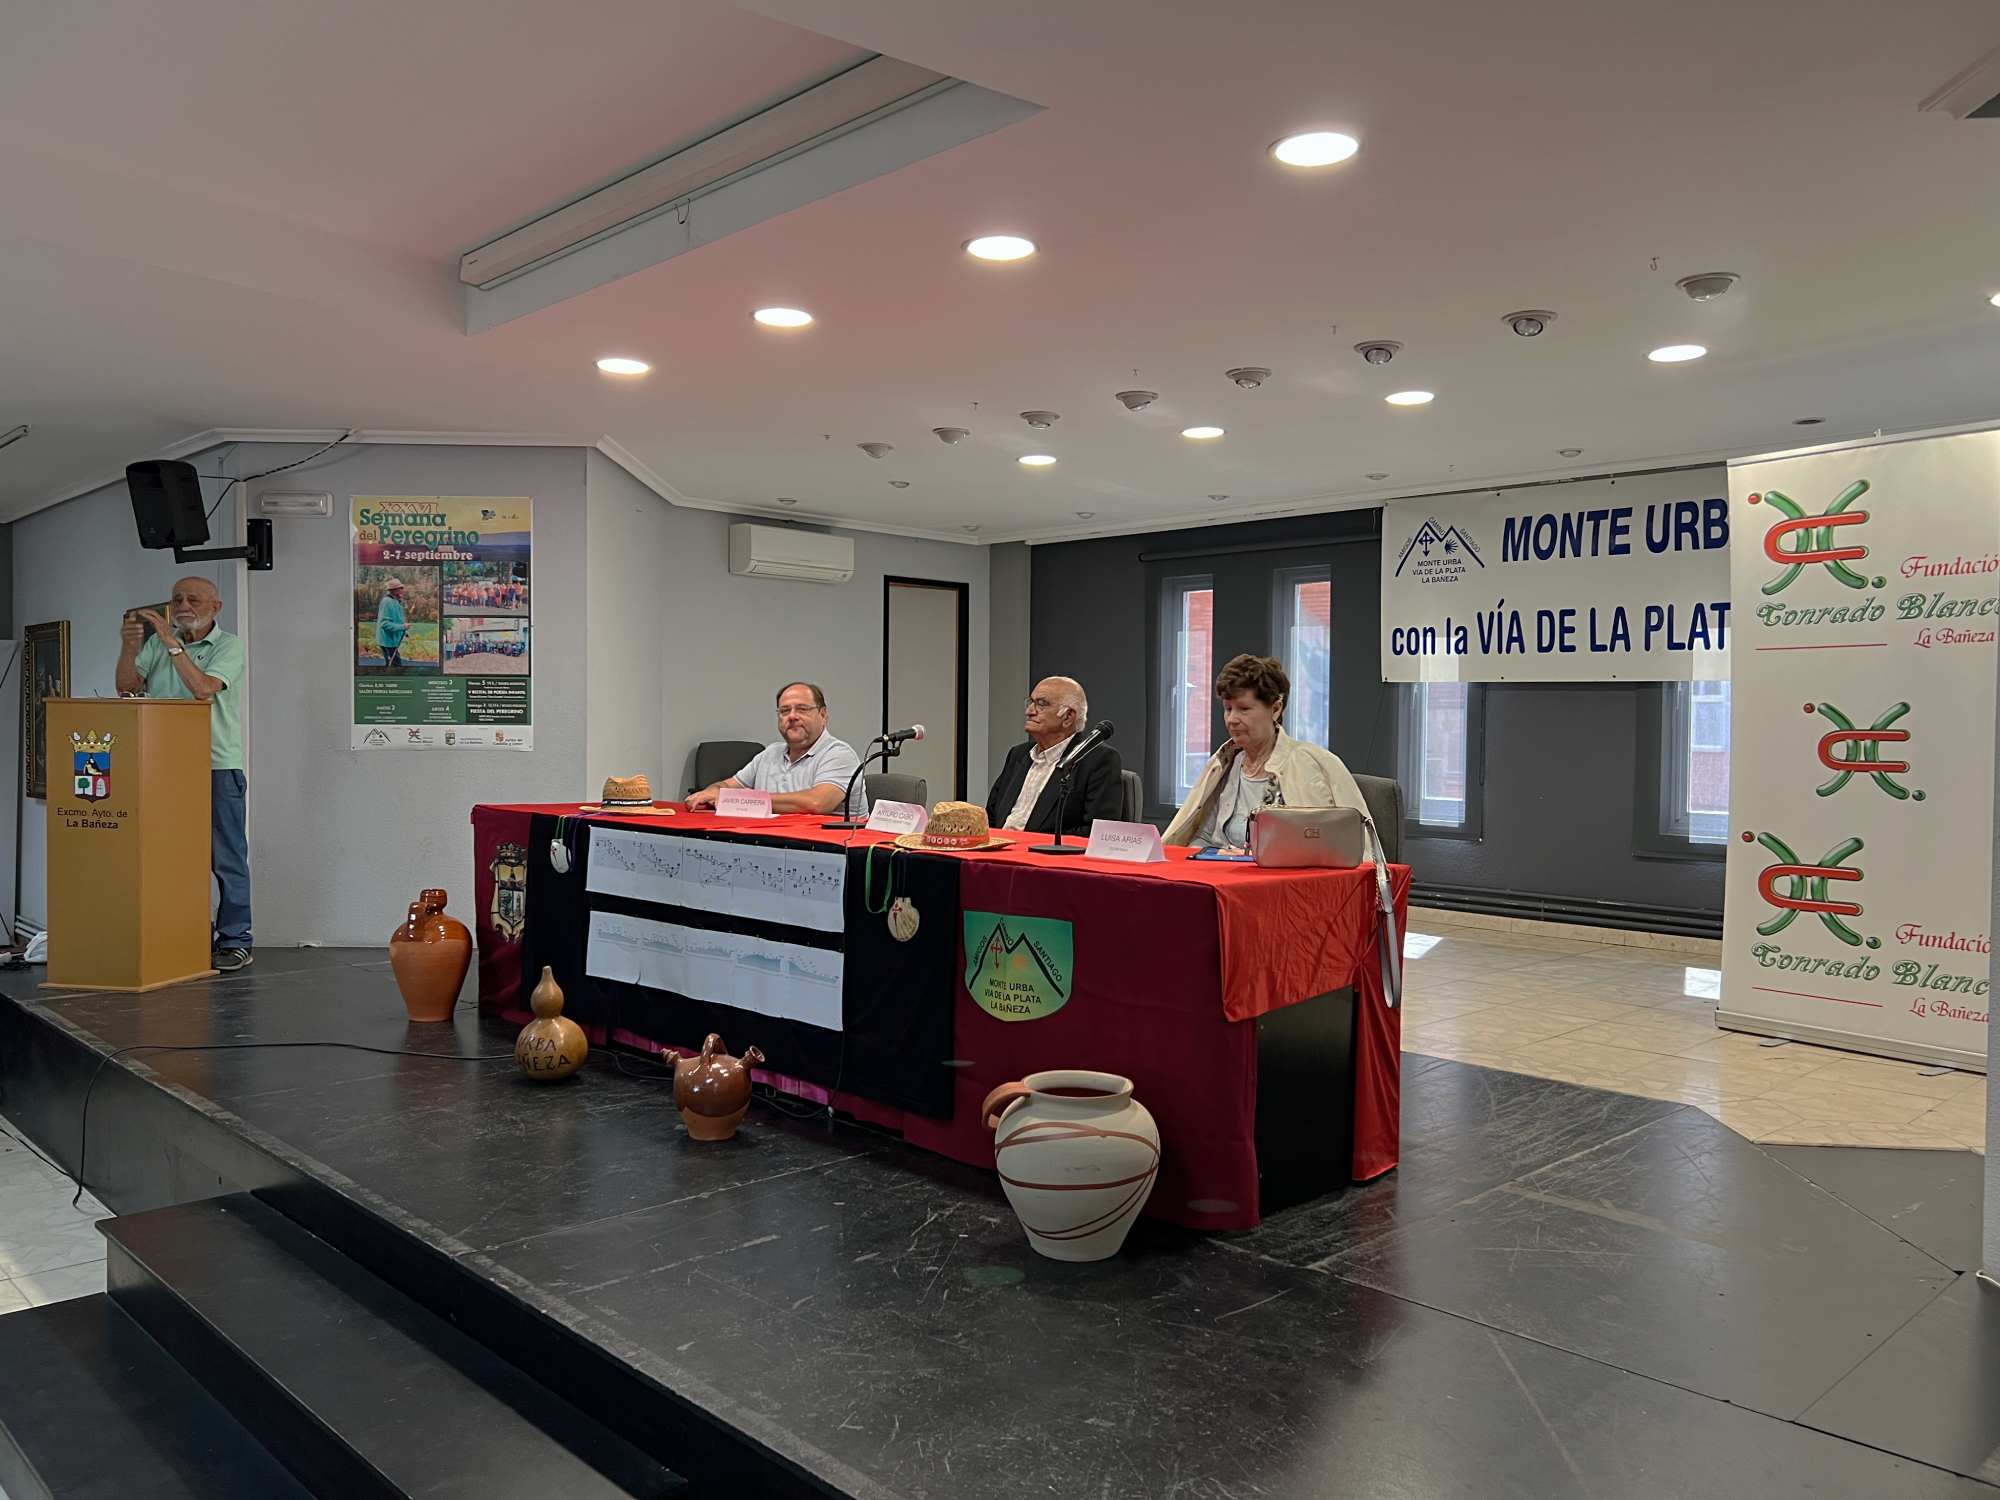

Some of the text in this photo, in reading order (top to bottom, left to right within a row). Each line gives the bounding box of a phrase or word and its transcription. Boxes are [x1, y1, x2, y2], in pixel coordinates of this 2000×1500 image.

[360, 508, 446, 526] Semana
[360, 530, 377, 541] del
[379, 525, 480, 550] Peregrino
[1502, 498, 1730, 563] MONTE URB
[383, 550, 473, 561] 2-7 septiembre
[1442, 558, 1462, 566] URBA
[1445, 566, 1466, 574] PLATA
[1900, 553, 1999, 579] Fundació
[1756, 596, 1886, 627] Conrado
[1391, 598, 1731, 656] con la VÍA DE LA PLAT
[1913, 627, 1995, 648] La Bañeza
[116, 809, 128, 818] de
[66, 818, 119, 829] La Bañeza
[1100, 832, 1120, 842] LUISA
[1895, 923, 1991, 954] Fundació
[1033, 940, 1063, 983] SANTIAGO
[1751, 942, 1990, 996] Conrado Blanc
[1009, 982, 1035, 993] URBA
[1013, 994, 1042, 1004] PLATA
[1909, 997, 1926, 1018] La
